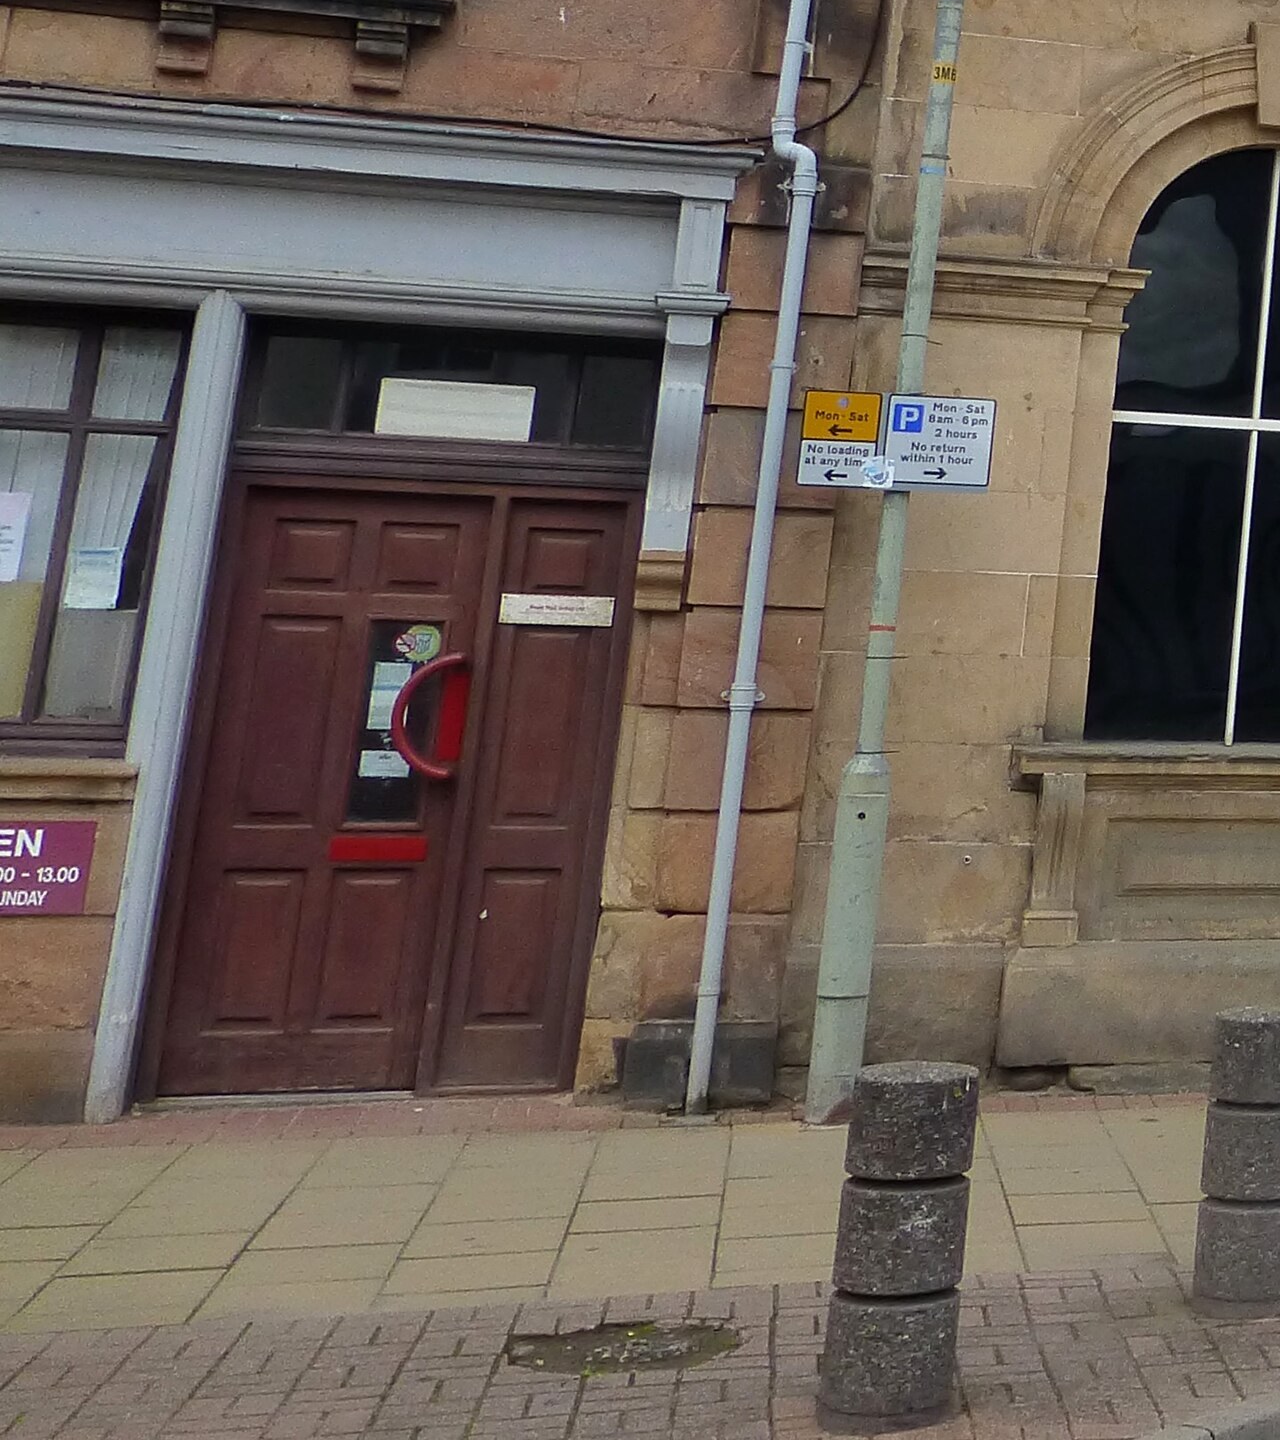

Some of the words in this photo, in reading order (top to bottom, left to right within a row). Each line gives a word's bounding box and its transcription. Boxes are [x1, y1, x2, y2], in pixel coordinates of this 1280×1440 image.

[933, 403, 957, 412] Mon
[966, 404, 985, 414] Sat
[815, 410, 839, 420] Mon
[849, 412, 869, 422] Sat
[900, 406, 919, 430] P
[934, 429, 942, 437] 2
[946, 429, 977, 439] hours
[807, 444, 823, 454] No
[828, 445, 869, 457] loading
[911, 442, 927, 451] No
[930, 444, 966, 453] return
[805, 456, 815, 464] at
[820, 458, 840, 467] any
[844, 457, 865, 466] tim
[900, 453, 935, 463] within
[948, 455, 974, 465] hour
[37, 866, 80, 883] 13.00
